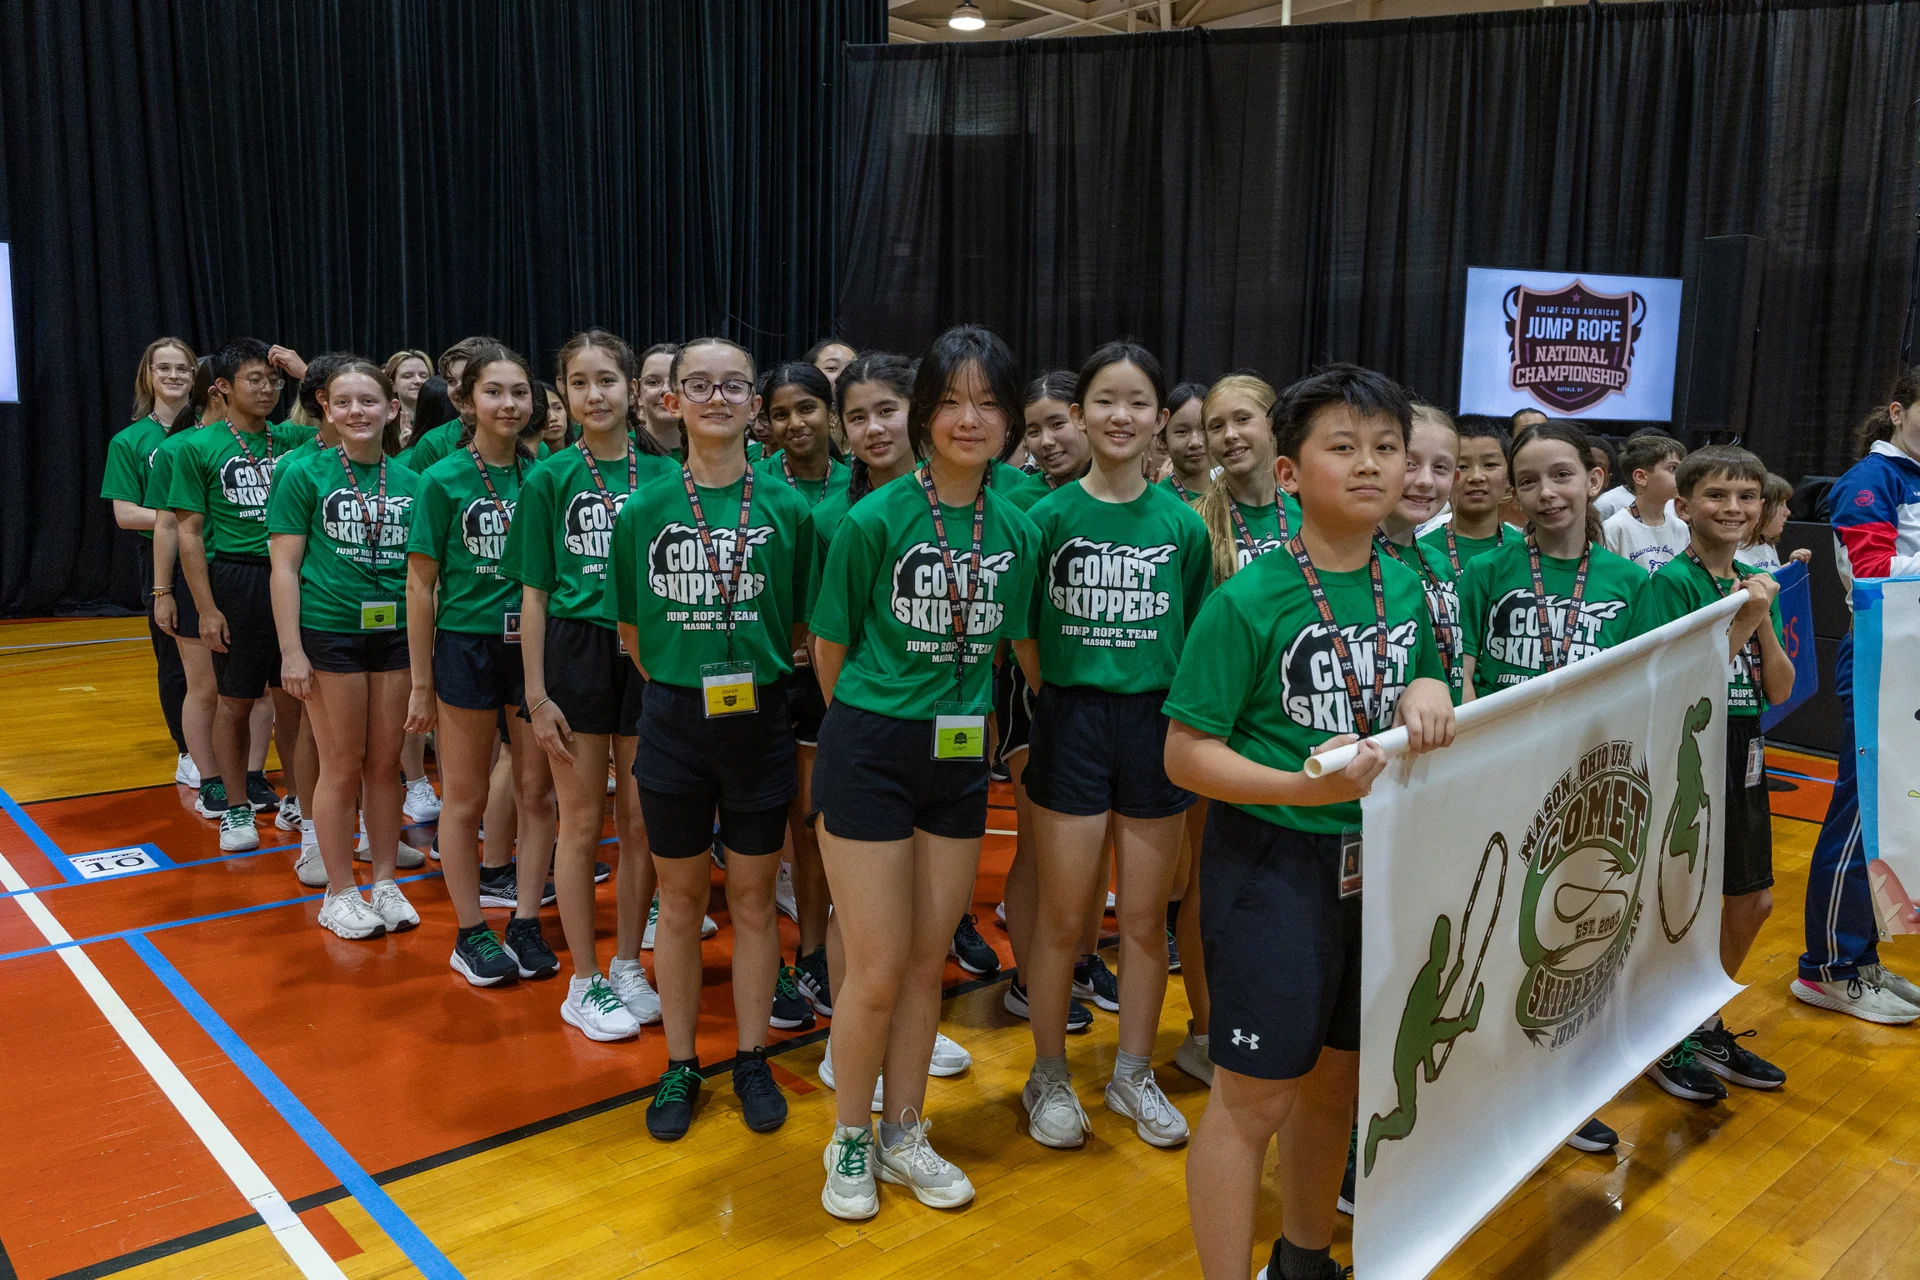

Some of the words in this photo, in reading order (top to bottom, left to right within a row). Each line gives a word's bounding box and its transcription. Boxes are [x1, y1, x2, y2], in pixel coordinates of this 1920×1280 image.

[1562, 306, 1580, 315] 2026
[1583, 308, 1620, 317] AMERICAN
[1525, 317, 1574, 340] JUMP
[1577, 318, 1622, 342] ROPE
[1535, 345, 1608, 365] NATIONAL
[1516, 366, 1625, 388] CHAMPIONSHIP
[239, 509, 260, 518] JUMP
[336, 547, 359, 556] JUMP
[382, 551, 405, 560] TEAM
[1068, 554, 1156, 590] COMET
[1052, 586, 1170, 622] SKIPPERS
[666, 611, 690, 622] JUMP
[692, 611, 722, 622] ROPE
[683, 622, 714, 630] MASON,
[716, 622, 736, 630] OHO
[1061, 625, 1090, 636] JUMP
[1092, 627, 1124, 638] ROPE
[1126, 628, 1158, 640] TEAM
[906, 640, 939, 652] JUMP
[941, 642, 967, 653] ROP
[1082, 638, 1114, 647] MASON,
[1116, 640, 1136, 648] OHIO
[1730, 688, 1754, 698] ROPE
[1518, 767, 1578, 868] MASON,
[1578, 742, 1610, 786] OHIO
[1611, 740, 1633, 770] USA
[1537, 776, 1649, 875] COMET
[85, 857, 144, 874] 10
[1575, 917, 1596, 941] EST.
[1527, 945, 1616, 1020] SKIPPERS
[1550, 1010, 1584, 1052] JUMP
